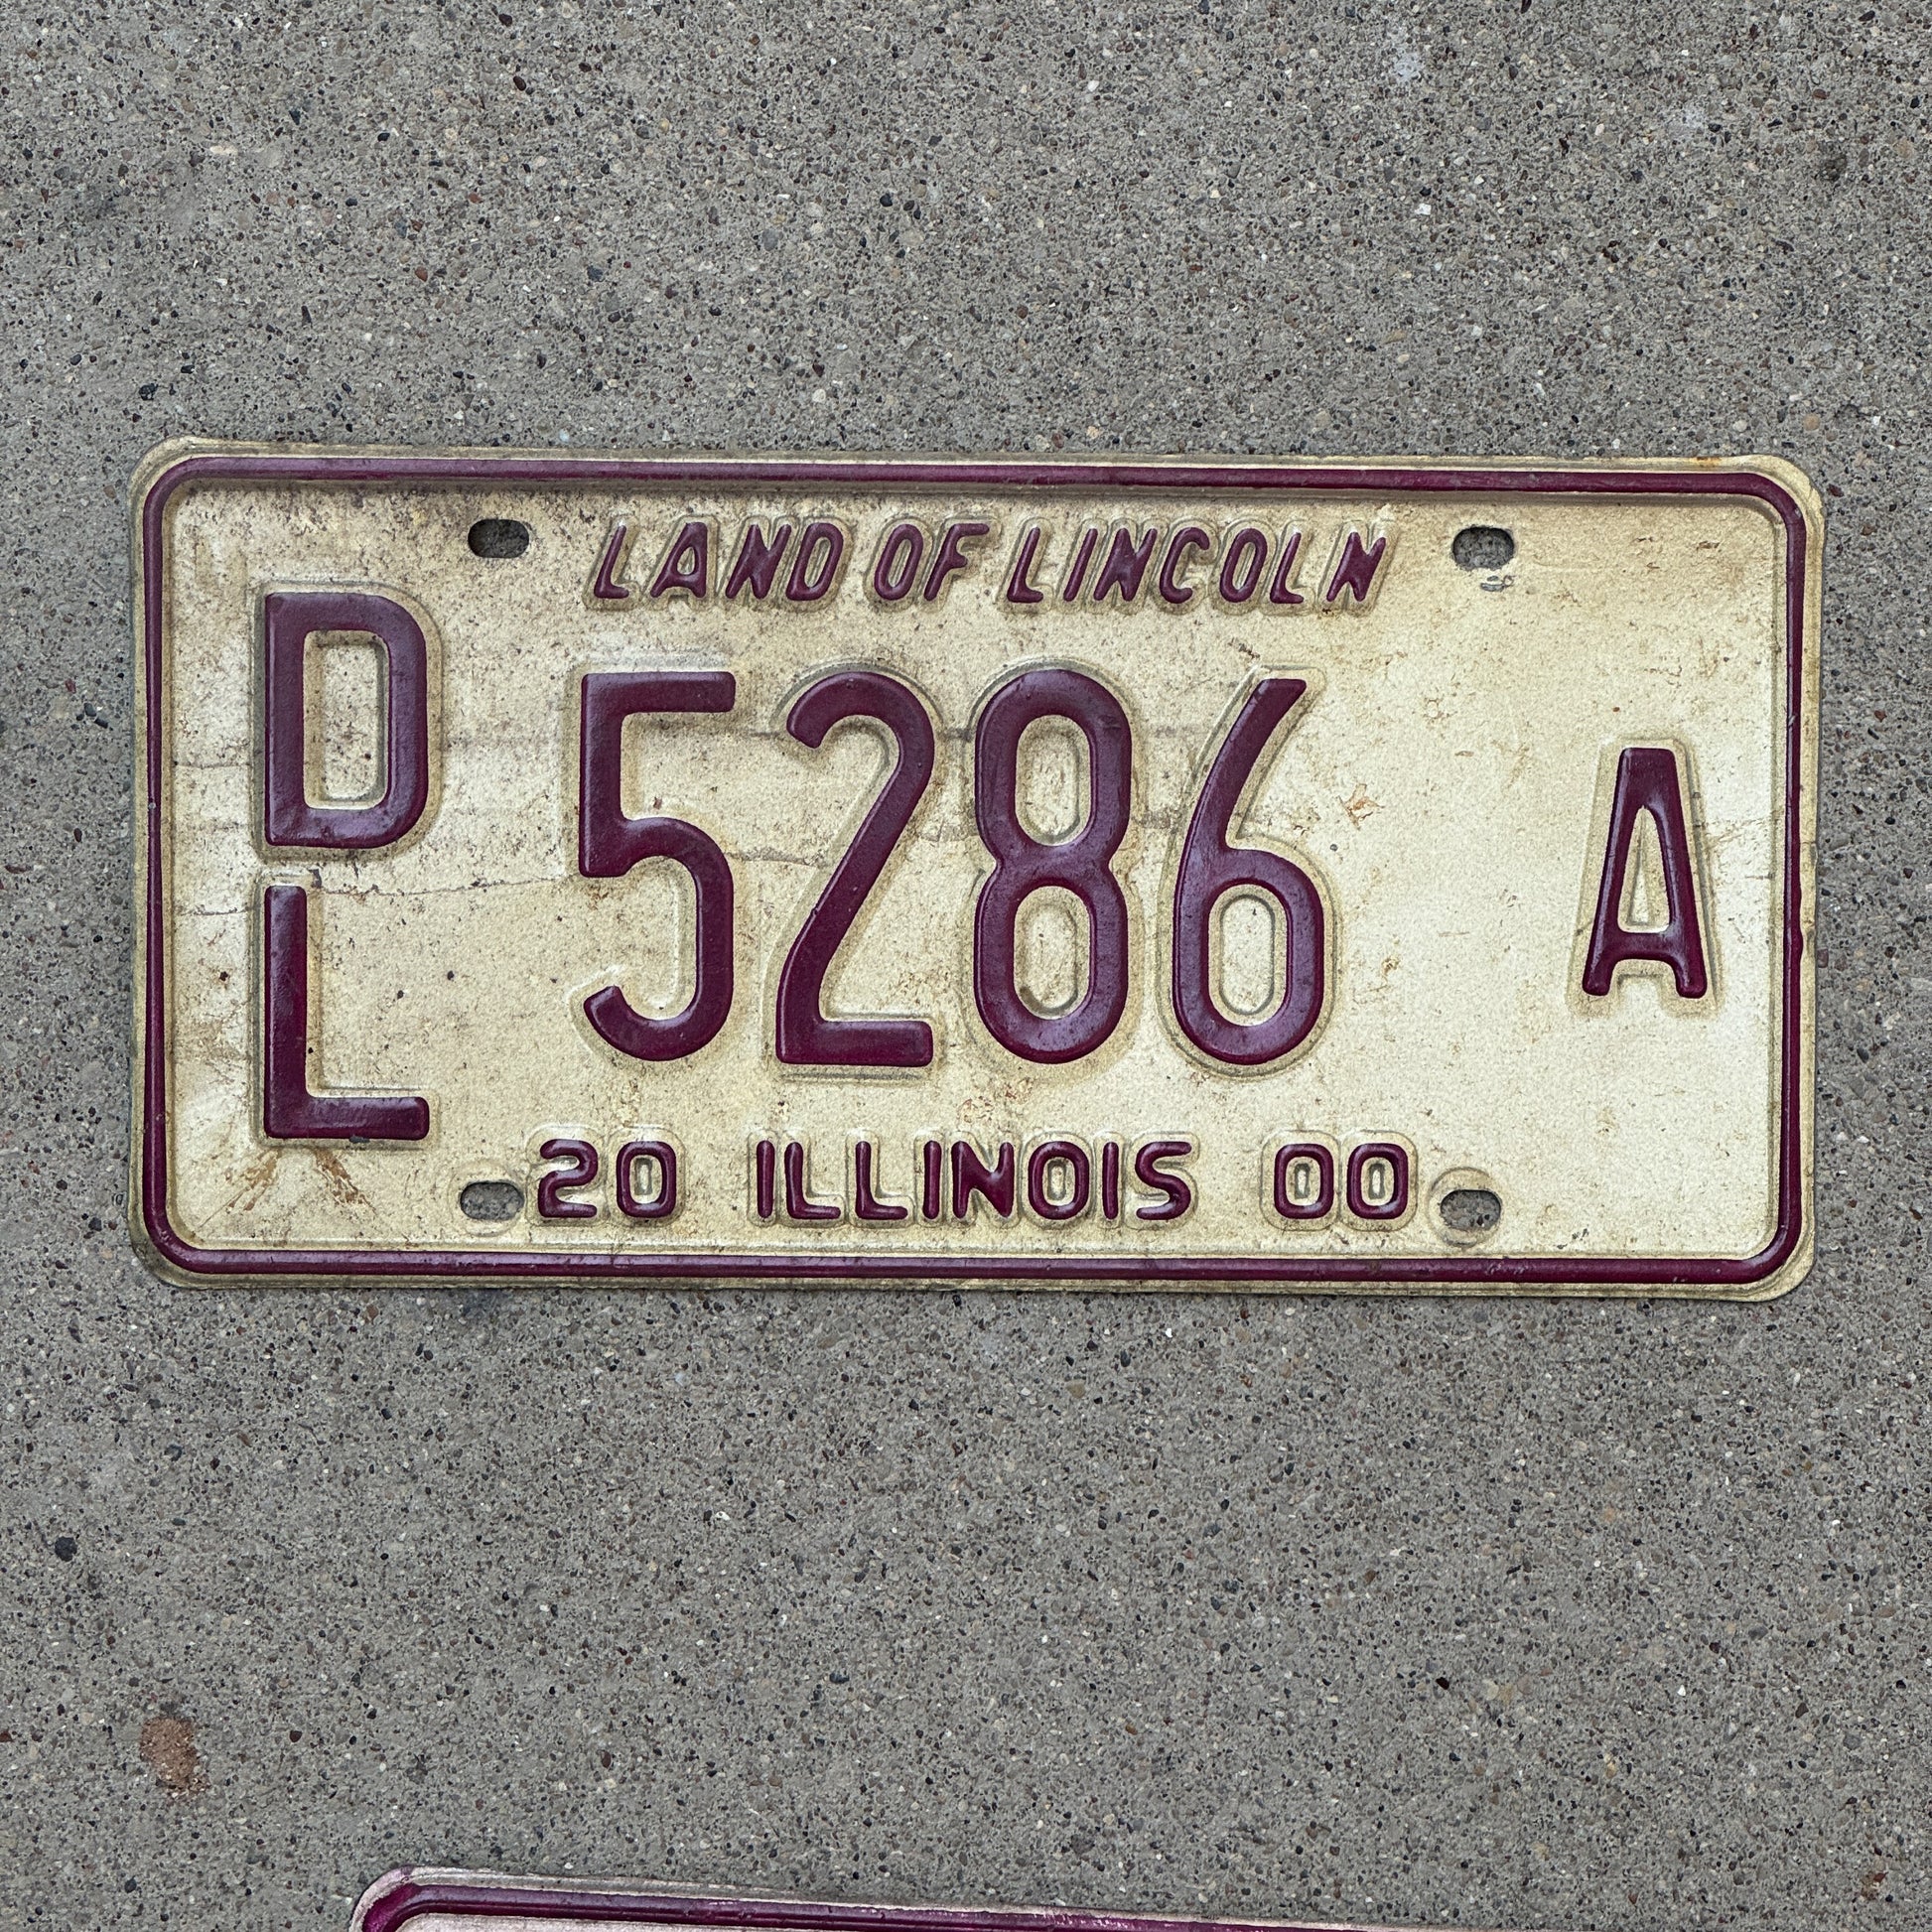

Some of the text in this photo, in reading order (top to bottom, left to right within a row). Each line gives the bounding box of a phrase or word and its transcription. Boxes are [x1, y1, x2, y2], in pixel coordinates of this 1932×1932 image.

[593, 521, 1389, 605] LAND OF LINCOLN
[576, 670, 1326, 1067] 5286
[1582, 746, 1709, 1000] A
[537, 1139, 1411, 1221] 20 ILLINOIS 00
